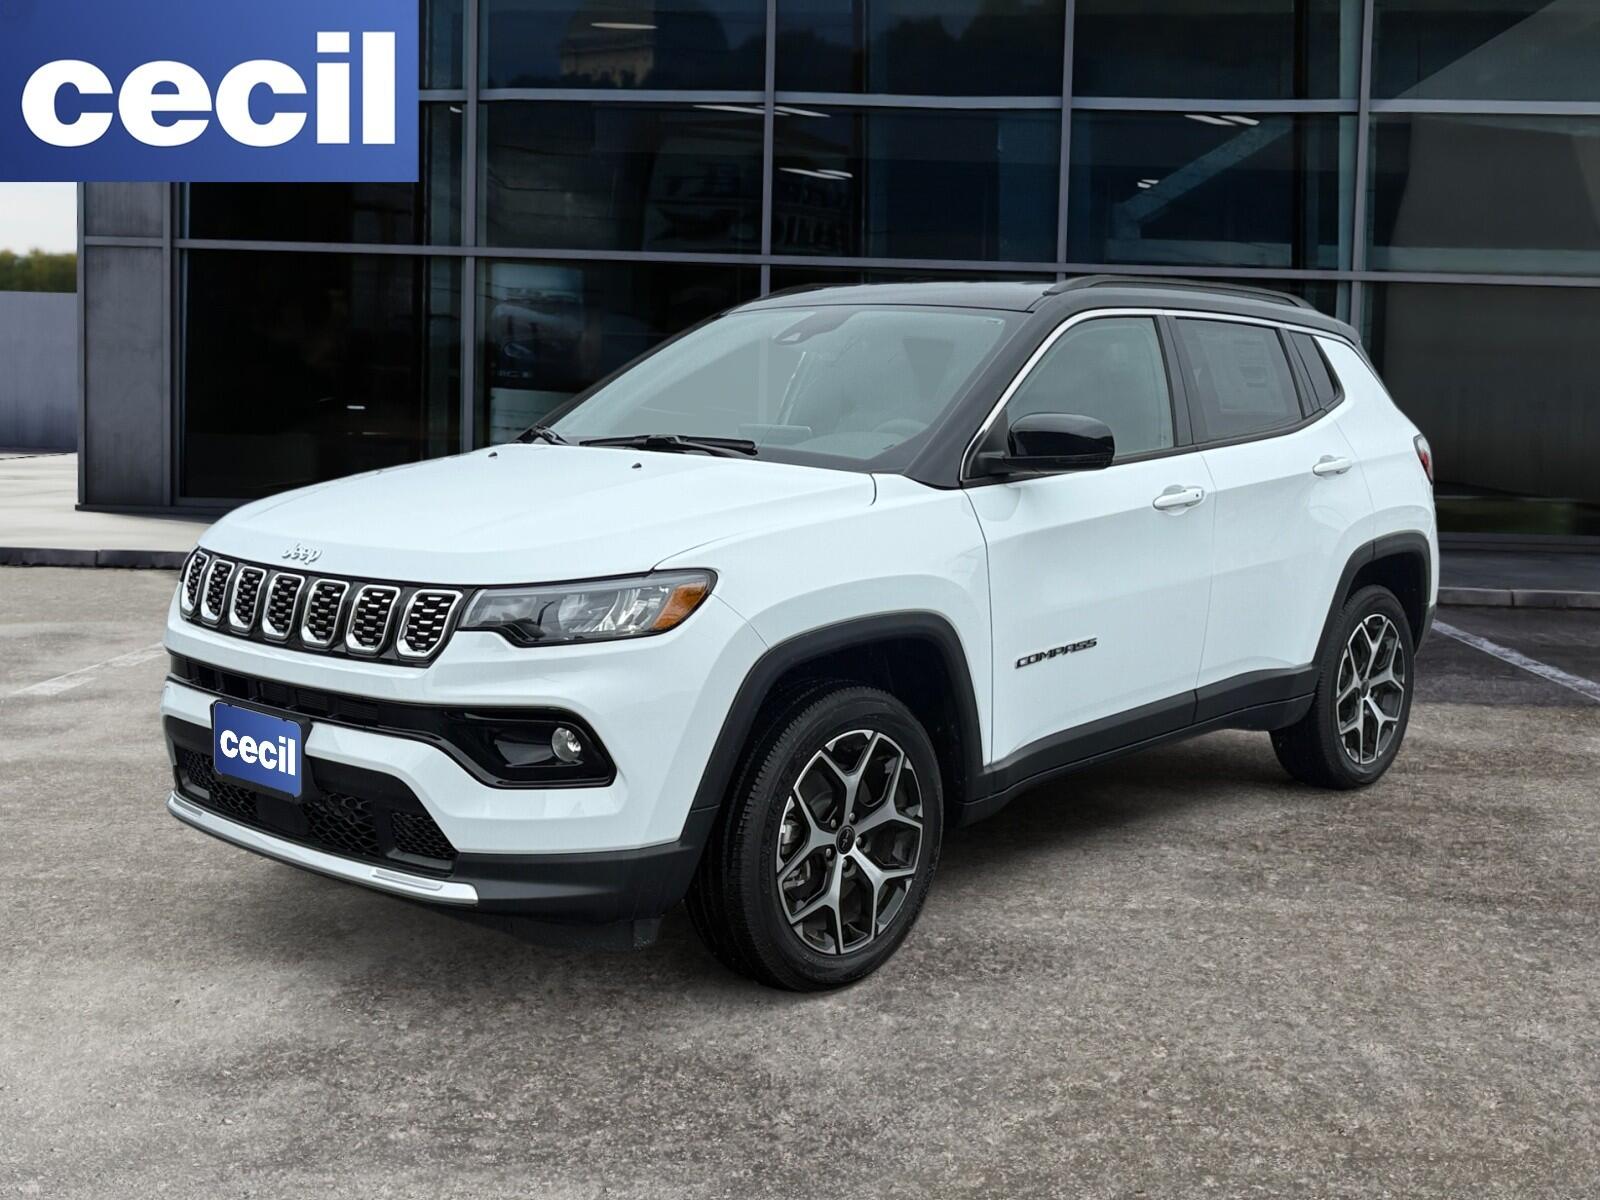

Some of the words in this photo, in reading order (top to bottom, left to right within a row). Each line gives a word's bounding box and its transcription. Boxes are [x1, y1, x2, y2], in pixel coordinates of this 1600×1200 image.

[281, 542, 323, 565] Jeep
[1015, 637, 1098, 670] COMPASS
[219, 729, 296, 776] cecil
